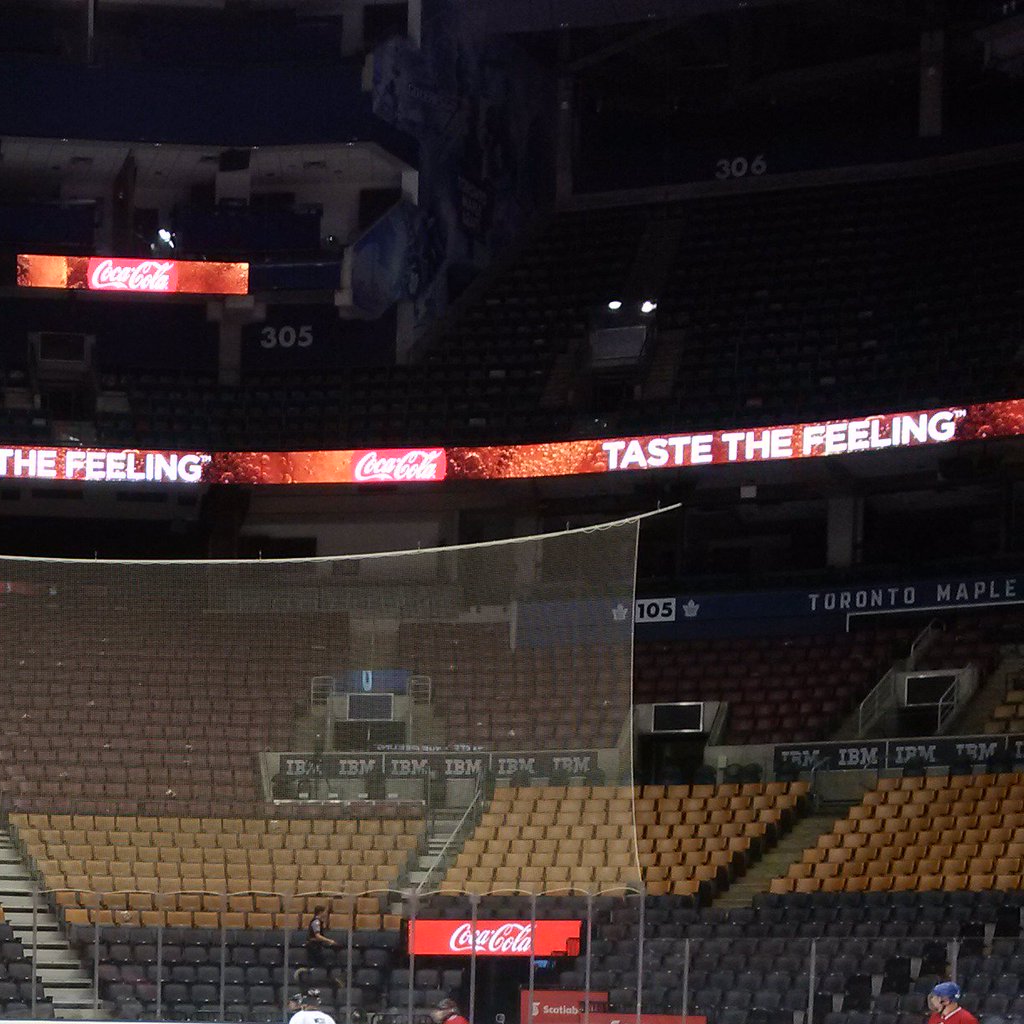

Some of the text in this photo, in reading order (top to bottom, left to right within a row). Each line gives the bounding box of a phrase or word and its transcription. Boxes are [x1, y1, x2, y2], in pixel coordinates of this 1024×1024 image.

[715, 156, 767, 180] 306
[260, 326, 314, 350] 305
[602, 434, 713, 471] TASTE
[722, 428, 794, 461] THE
[808, 578, 1017, 611] TORONTO MAPLE
[637, 601, 673, 618] 105
[838, 748, 878, 765] IBM
[339, 759, 375, 775] IBM
[391, 759, 428, 775] IBM
[445, 758, 481, 775] IBM
[498, 758, 536, 775] IBM
[543, 1005, 584, 1015] Scotiab
